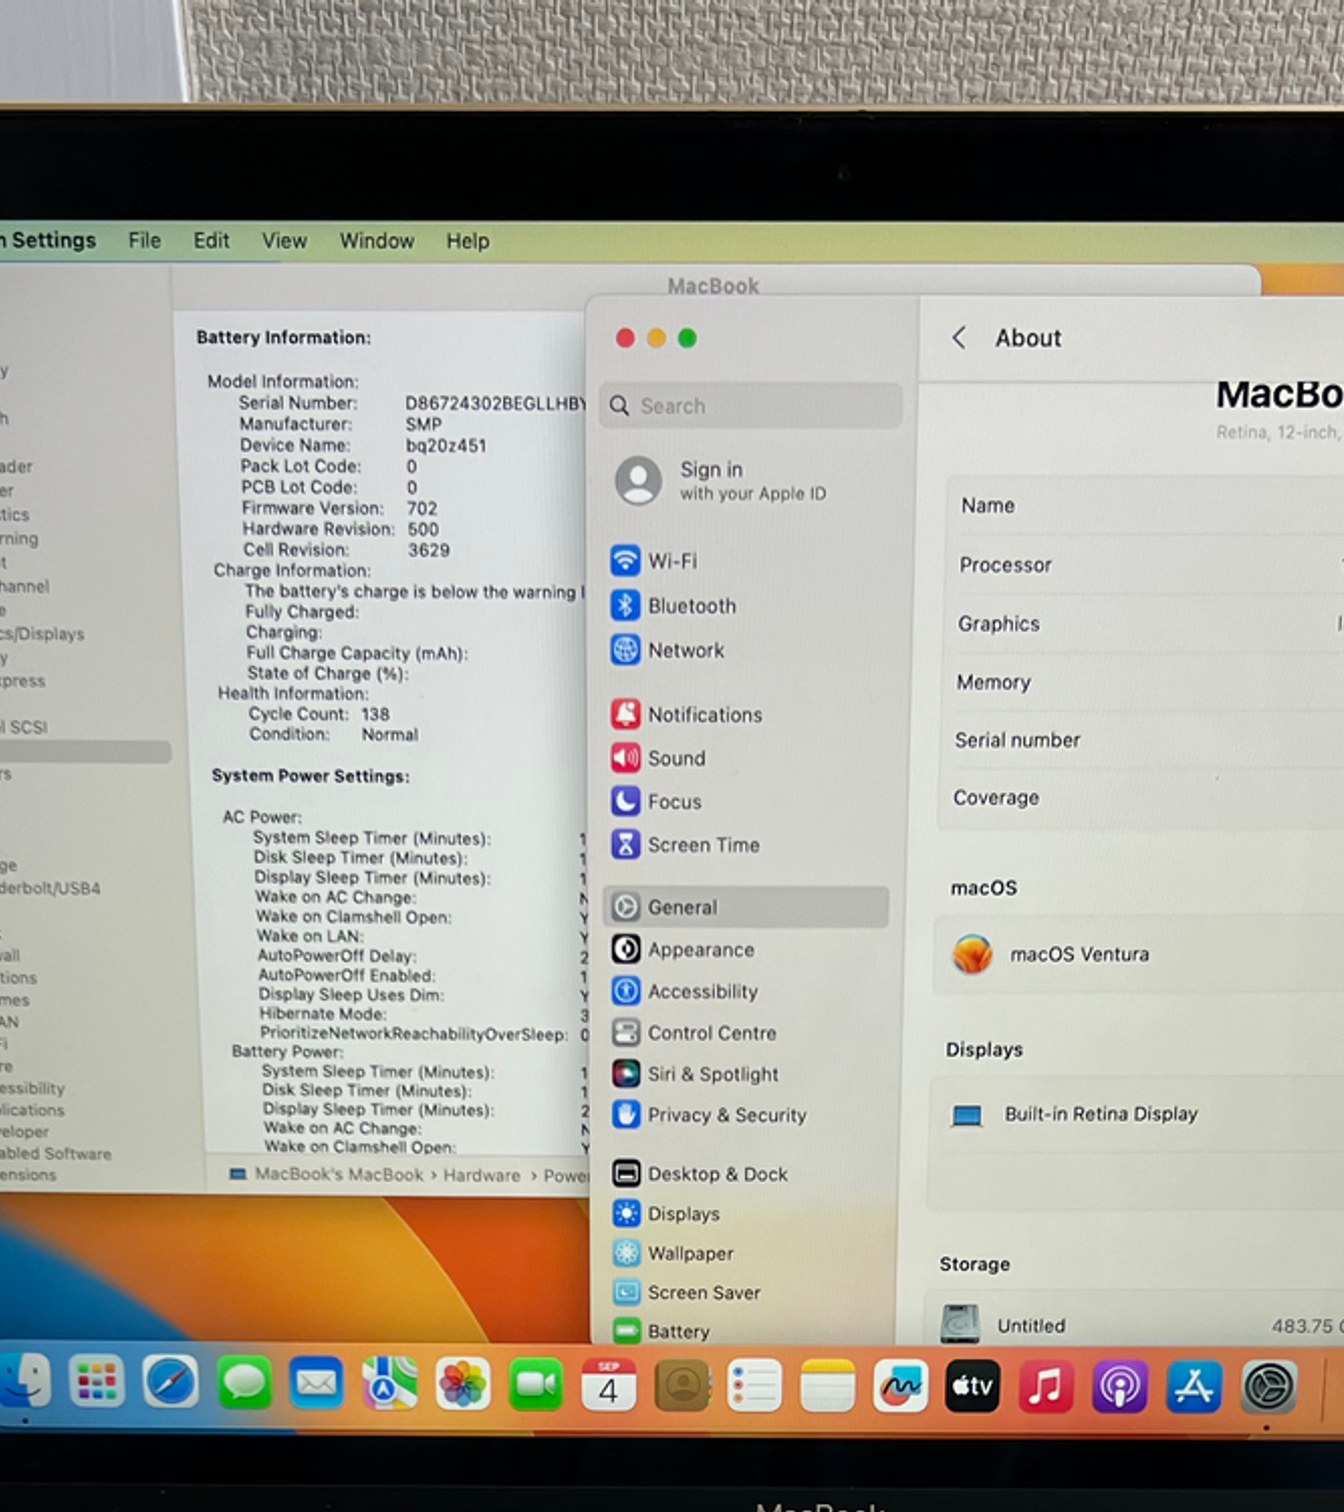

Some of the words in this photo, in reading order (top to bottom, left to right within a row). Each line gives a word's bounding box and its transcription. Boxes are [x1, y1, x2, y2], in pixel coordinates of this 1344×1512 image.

[12, 229, 97, 253] Settings
[128, 231, 162, 249] File
[194, 231, 230, 249] Edit
[262, 232, 308, 249] View
[339, 232, 415, 250] Window
[447, 232, 490, 252] Help
[668, 277, 760, 295] MacBook
[196, 329, 261, 348] Battery
[265, 329, 371, 345] Information:
[995, 327, 1062, 348] About
[238, 394, 284, 411] Serial
[288, 395, 358, 411] Number:
[640, 396, 706, 415] Search
[239, 415, 353, 432] Manufacturer:
[405, 416, 443, 432] SMP
[1216, 424, 1271, 443] Retina,
[1278, 423, 1342, 443] 12-inch,
[240, 436, 295, 453] Device
[299, 437, 351, 453] Name:
[405, 437, 486, 456] bq20z451
[679, 485, 714, 501] with
[718, 488, 754, 504] your
[758, 485, 806, 504] Apple
[810, 485, 827, 501] ID
[241, 499, 315, 516] Firmware
[319, 500, 384, 516] Version:
[407, 500, 438, 517] 702
[961, 496, 1016, 514] Name
[648, 552, 698, 570] Wi-Fi
[960, 555, 1053, 574] Processor
[648, 596, 737, 615] Bluetooth
[958, 614, 1041, 635] Graphics
[648, 641, 725, 659] Network
[957, 673, 1032, 694] Memory
[248, 705, 293, 724] Cycle
[296, 705, 349, 722] Count:
[361, 706, 391, 722] 138
[648, 705, 763, 724] Notifications
[955, 731, 1006, 749] Serial
[1010, 731, 1081, 749] number
[648, 749, 706, 768] Sound
[953, 788, 1040, 810] Coverage
[648, 836, 711, 854] Screen
[716, 836, 761, 854] Time
[950, 879, 1018, 897] macOS
[647, 898, 718, 916] General
[648, 941, 755, 961] Appearance
[1010, 945, 1075, 963] macOS
[1080, 946, 1150, 963] Ventura
[648, 983, 759, 1003] Accessibility
[946, 1041, 1024, 1061] Displays
[1005, 1105, 1068, 1122] Built-in
[1073, 1105, 1129, 1122] Retina
[1133, 1105, 1199, 1125] Display
[648, 1205, 721, 1225] Displays
[647, 1245, 734, 1264] Wallpaper
[939, 1256, 1011, 1276] Storage
[648, 1323, 711, 1343] Battery
[997, 1318, 1066, 1334] Untitled
[1272, 1318, 1333, 1334] 483.75
[598, 1361, 620, 1371] SEP
[598, 1378, 618, 1404] 4
